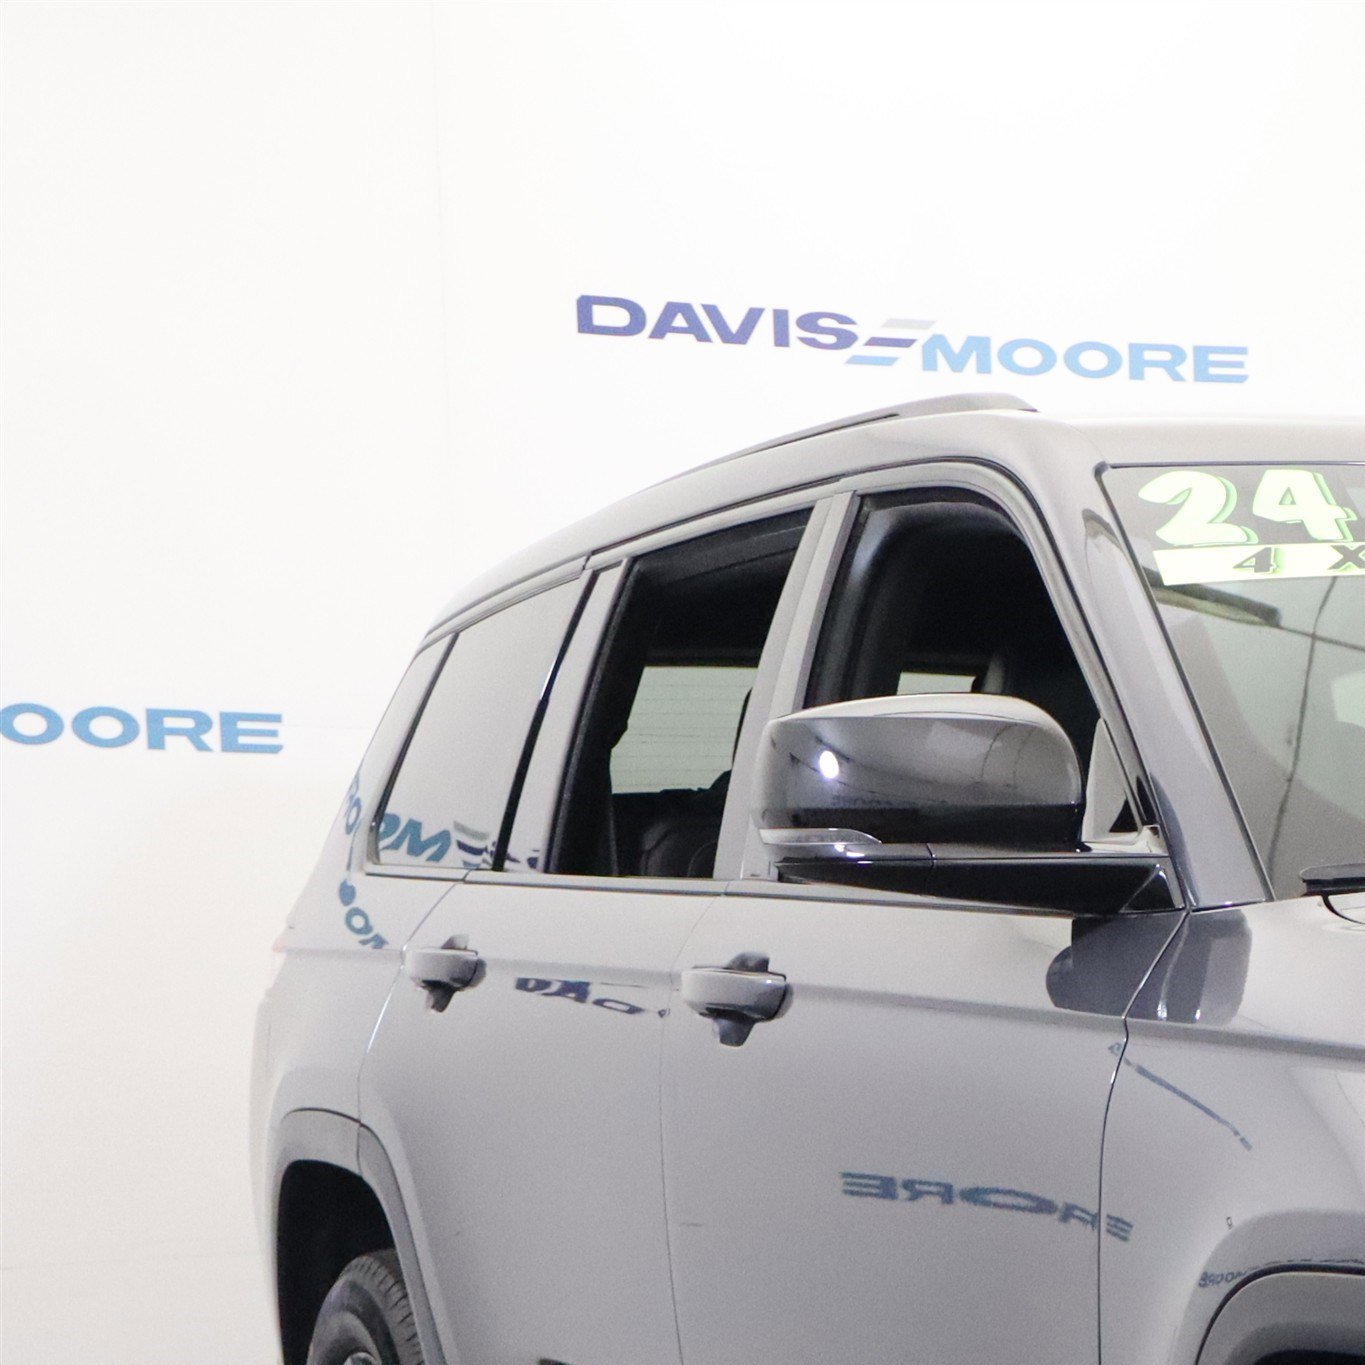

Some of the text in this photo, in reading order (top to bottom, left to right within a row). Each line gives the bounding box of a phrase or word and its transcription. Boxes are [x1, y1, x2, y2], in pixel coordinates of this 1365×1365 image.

[576, 294, 1248, 384] DAVIS MOORE
[1138, 469, 1357, 546] 24
[1233, 547, 1282, 574] 4
